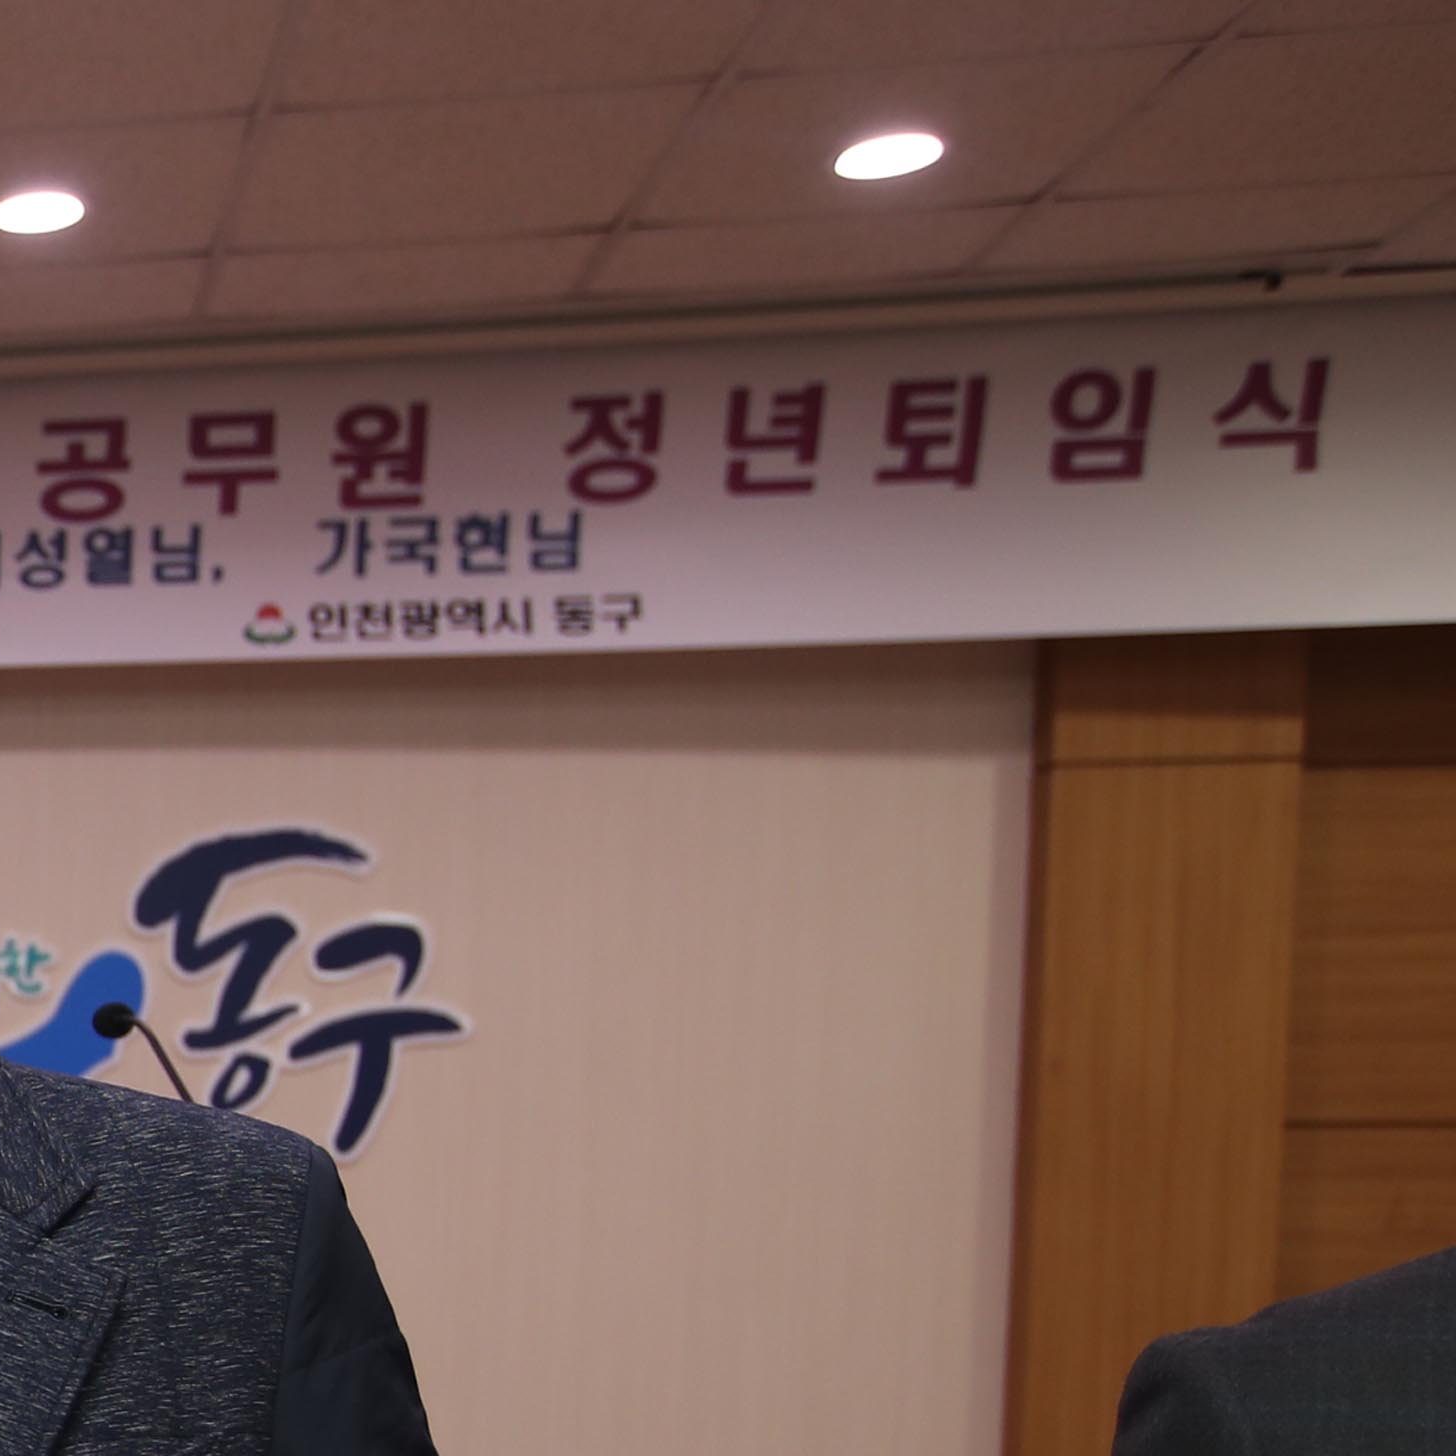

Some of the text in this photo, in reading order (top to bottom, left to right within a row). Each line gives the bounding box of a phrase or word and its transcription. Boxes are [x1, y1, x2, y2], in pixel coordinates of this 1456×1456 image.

[36, 401, 430, 523] 공무원
[314, 508, 583, 578] 가국현님
[307, 592, 645, 643] 인천광역시 동구
[134, 827, 465, 1153] 동구
